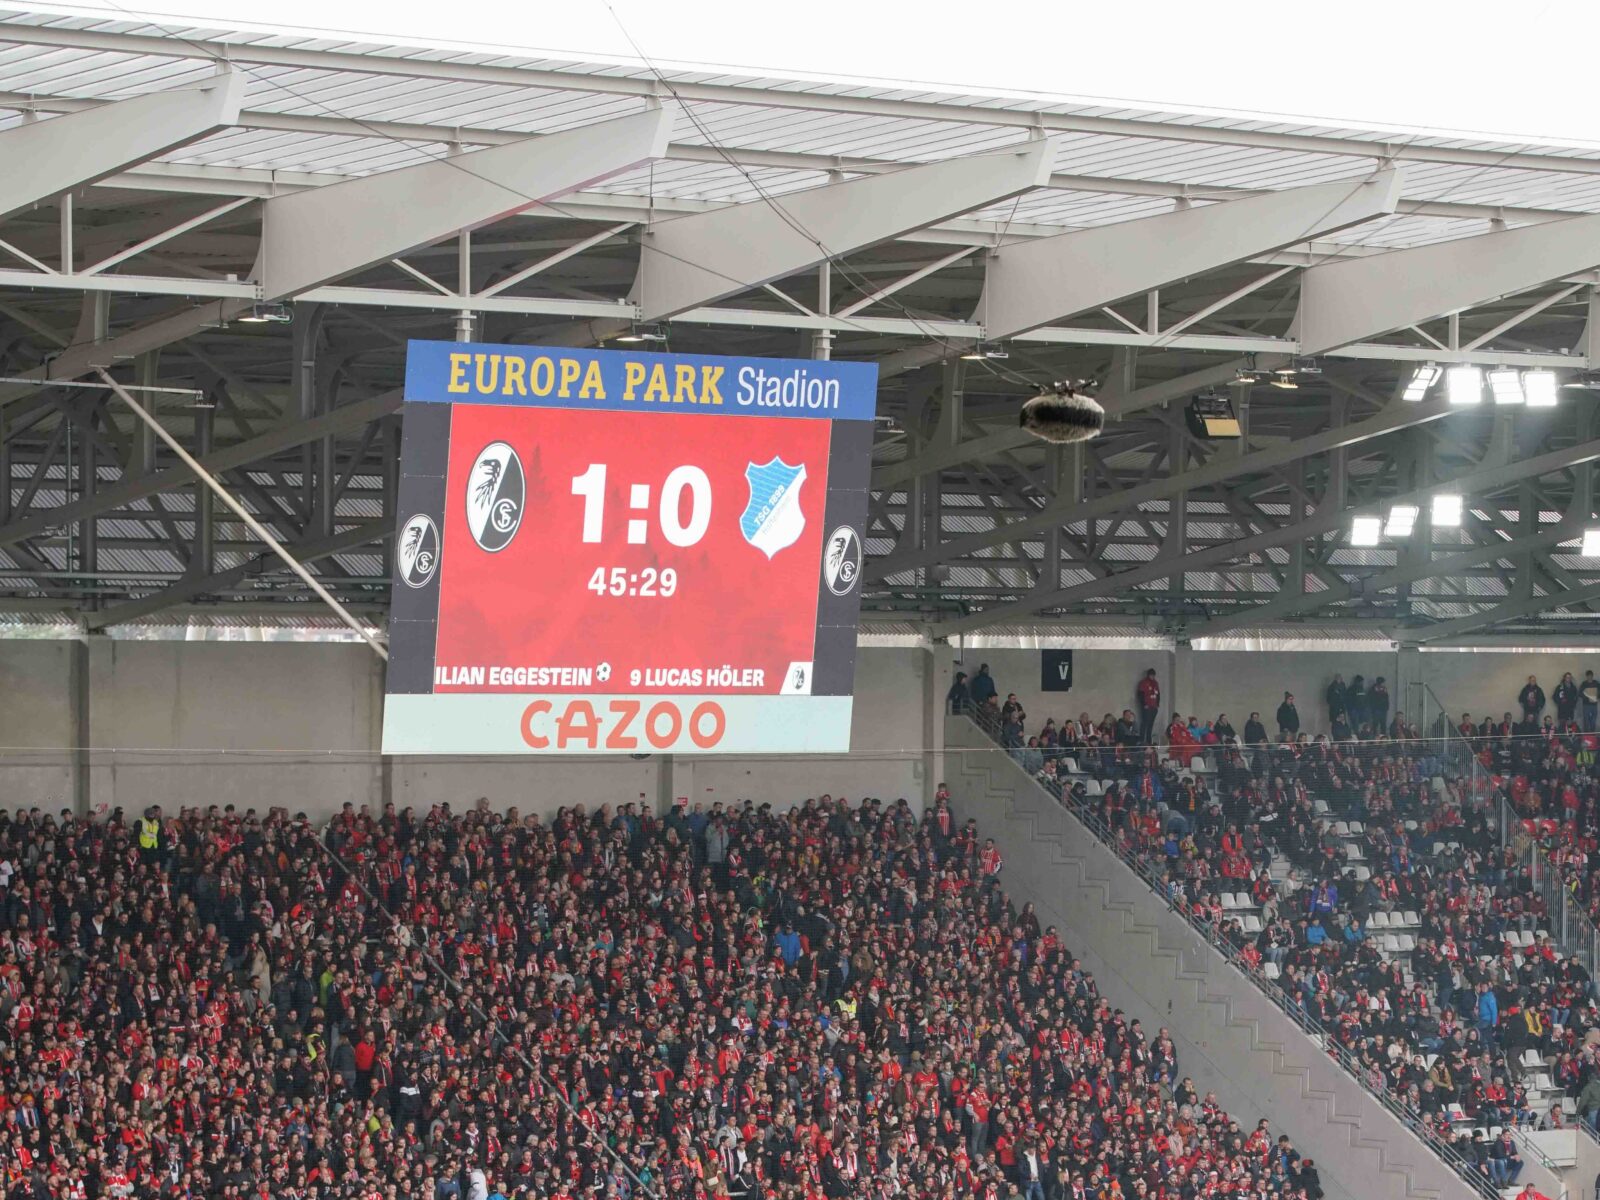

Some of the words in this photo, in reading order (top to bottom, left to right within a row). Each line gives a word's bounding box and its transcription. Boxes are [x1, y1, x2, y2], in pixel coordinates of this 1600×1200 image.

[447, 353, 606, 399] EUROPA
[623, 362, 724, 405] PARK
[736, 366, 840, 409] Stadion
[571, 463, 713, 547] 1:0
[588, 567, 677, 597] 45:29
[435, 666, 485, 685] ILIAN
[489, 666, 592, 686] EGGESTEIN
[630, 669, 641, 686] 9
[645, 668, 702, 686] LUCAS
[706, 665, 765, 686] HÖLER
[520, 700, 726, 749] CAZOO
